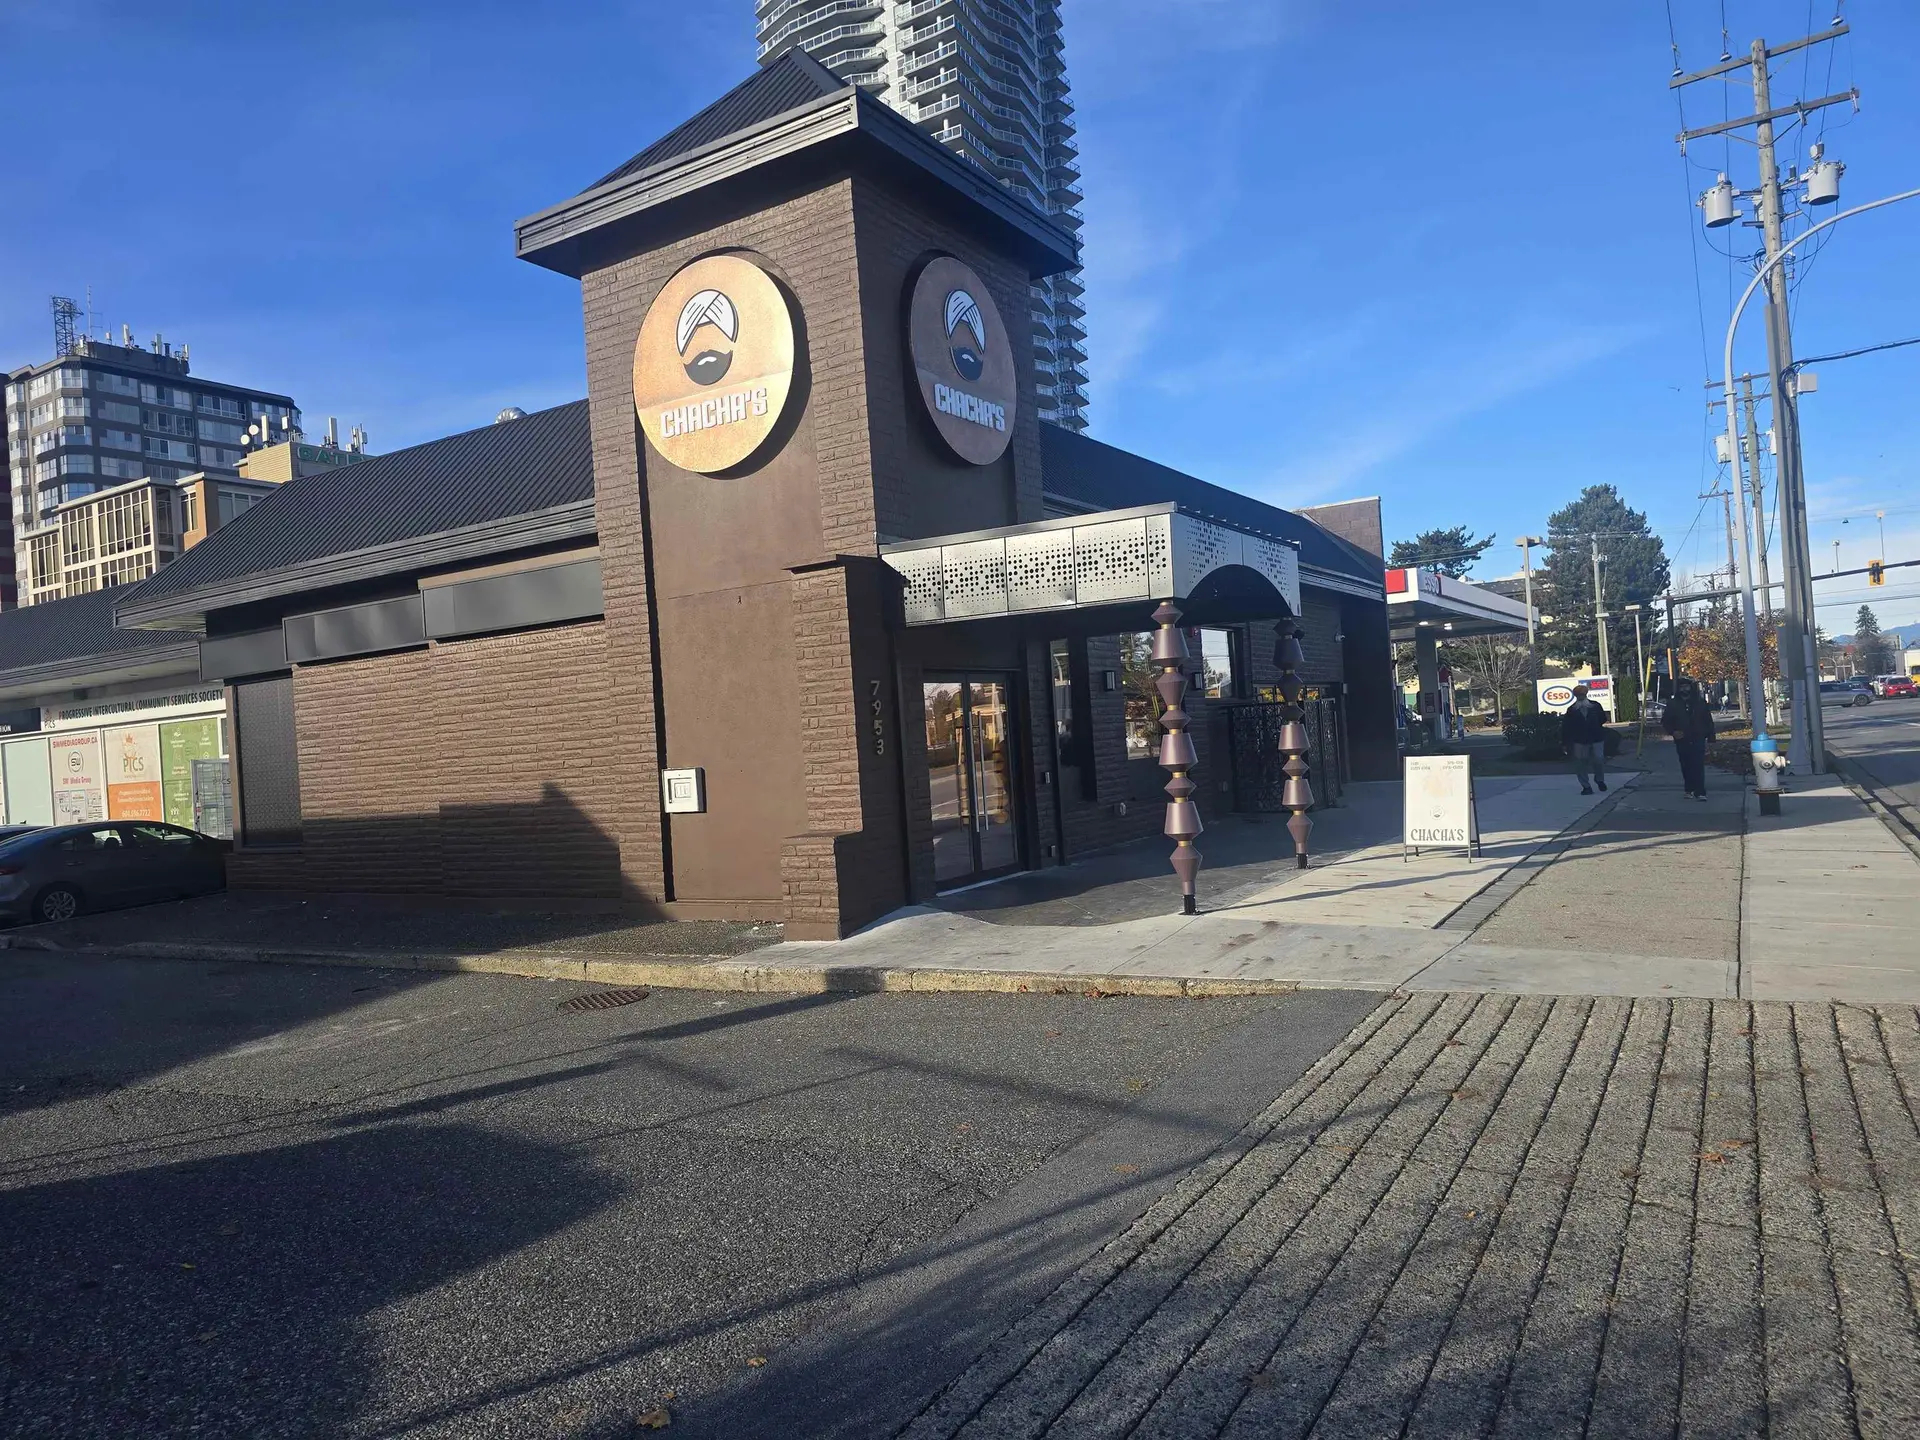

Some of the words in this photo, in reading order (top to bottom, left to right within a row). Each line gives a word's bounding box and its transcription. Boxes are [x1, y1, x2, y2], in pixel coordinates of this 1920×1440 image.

[661, 387, 768, 438] CHACHA'S
[934, 383, 1006, 432] CHACHA'S
[297, 446, 364, 465] GATE
[59, 706, 92, 720] PROGRESSIVE
[93, 701, 135, 716] INTERCULTURAL
[136, 696, 170, 711] COMMUNITY
[170, 692, 198, 707] SERVICES
[199, 689, 223, 702] SOCIETY
[870, 680, 884, 755] 7953
[123, 756, 144, 773] PICS
[1410, 828, 1465, 842] CHACHA'S
